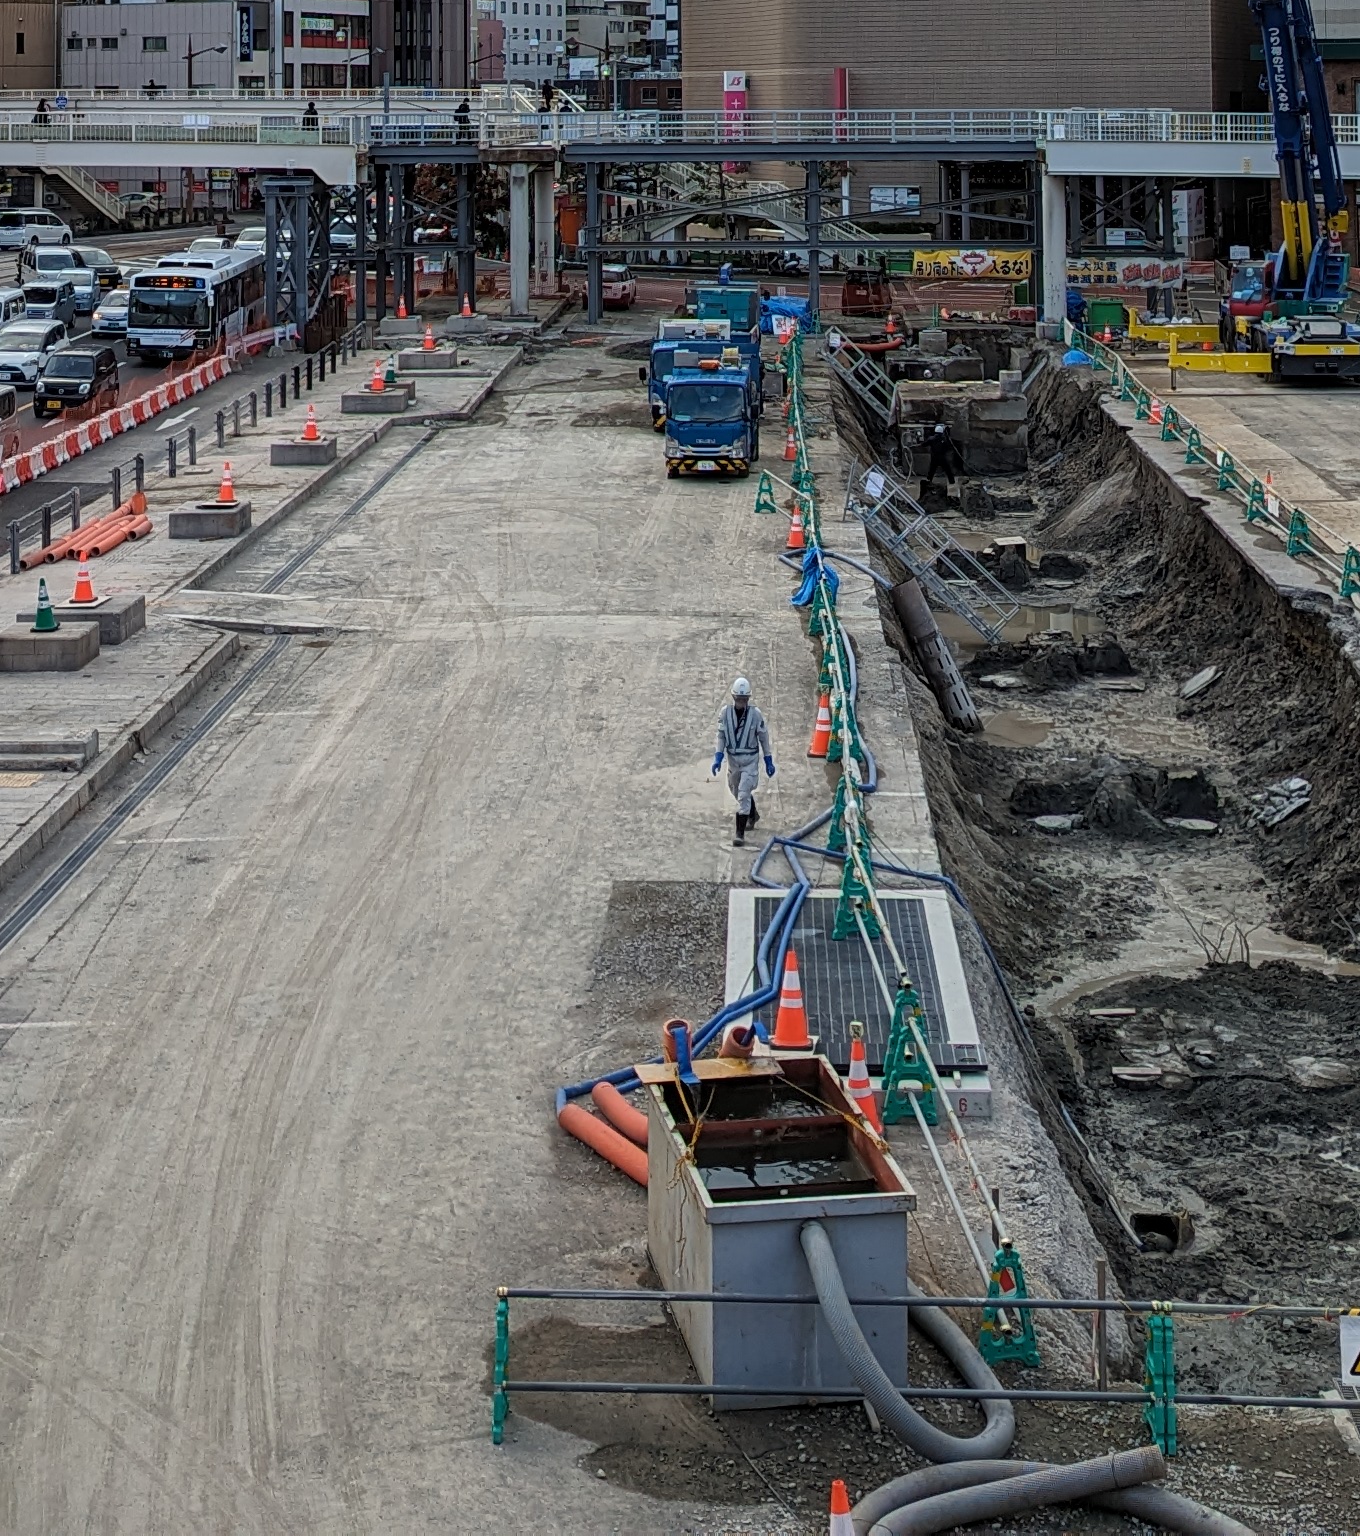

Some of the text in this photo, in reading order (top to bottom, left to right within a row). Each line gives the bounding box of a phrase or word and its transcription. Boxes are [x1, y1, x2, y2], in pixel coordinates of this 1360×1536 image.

[1268, 27, 1292, 112] つり荷の下に入るな
[915, 260, 1029, 276] 吊り荷の下に 入るな!
